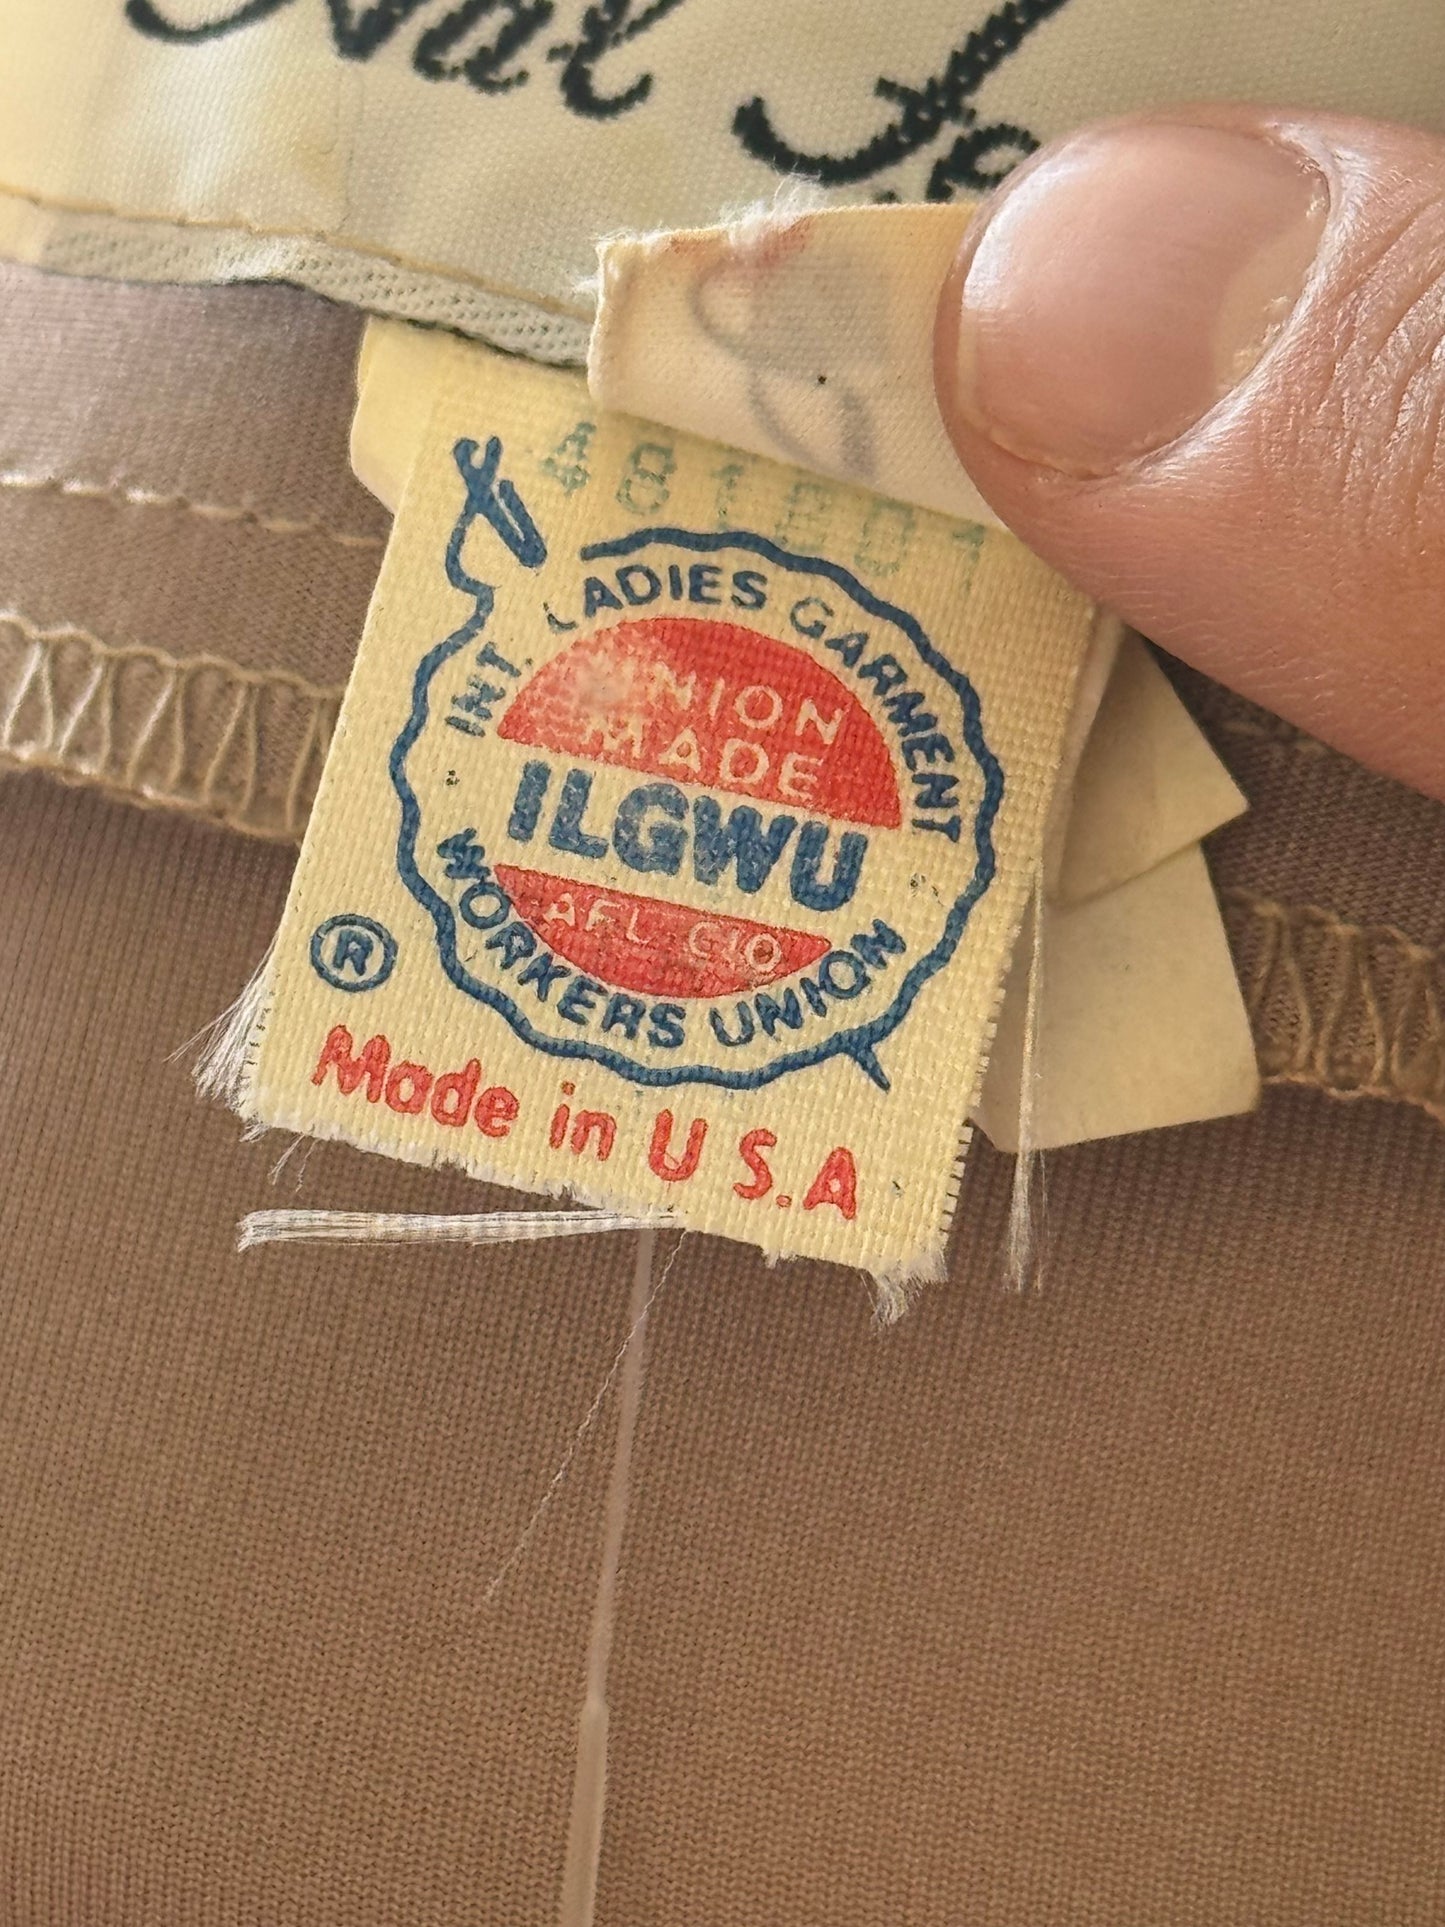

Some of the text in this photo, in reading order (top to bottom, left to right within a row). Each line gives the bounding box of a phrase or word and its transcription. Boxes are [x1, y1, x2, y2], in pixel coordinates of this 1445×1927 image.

[790, 597, 962, 843] GARMENT
[507, 761, 868, 911] ILGWU
[437, 829, 906, 1048] WORKERS UNION
[312, 1025, 519, 1138] Made
[549, 1082, 617, 1160] in
